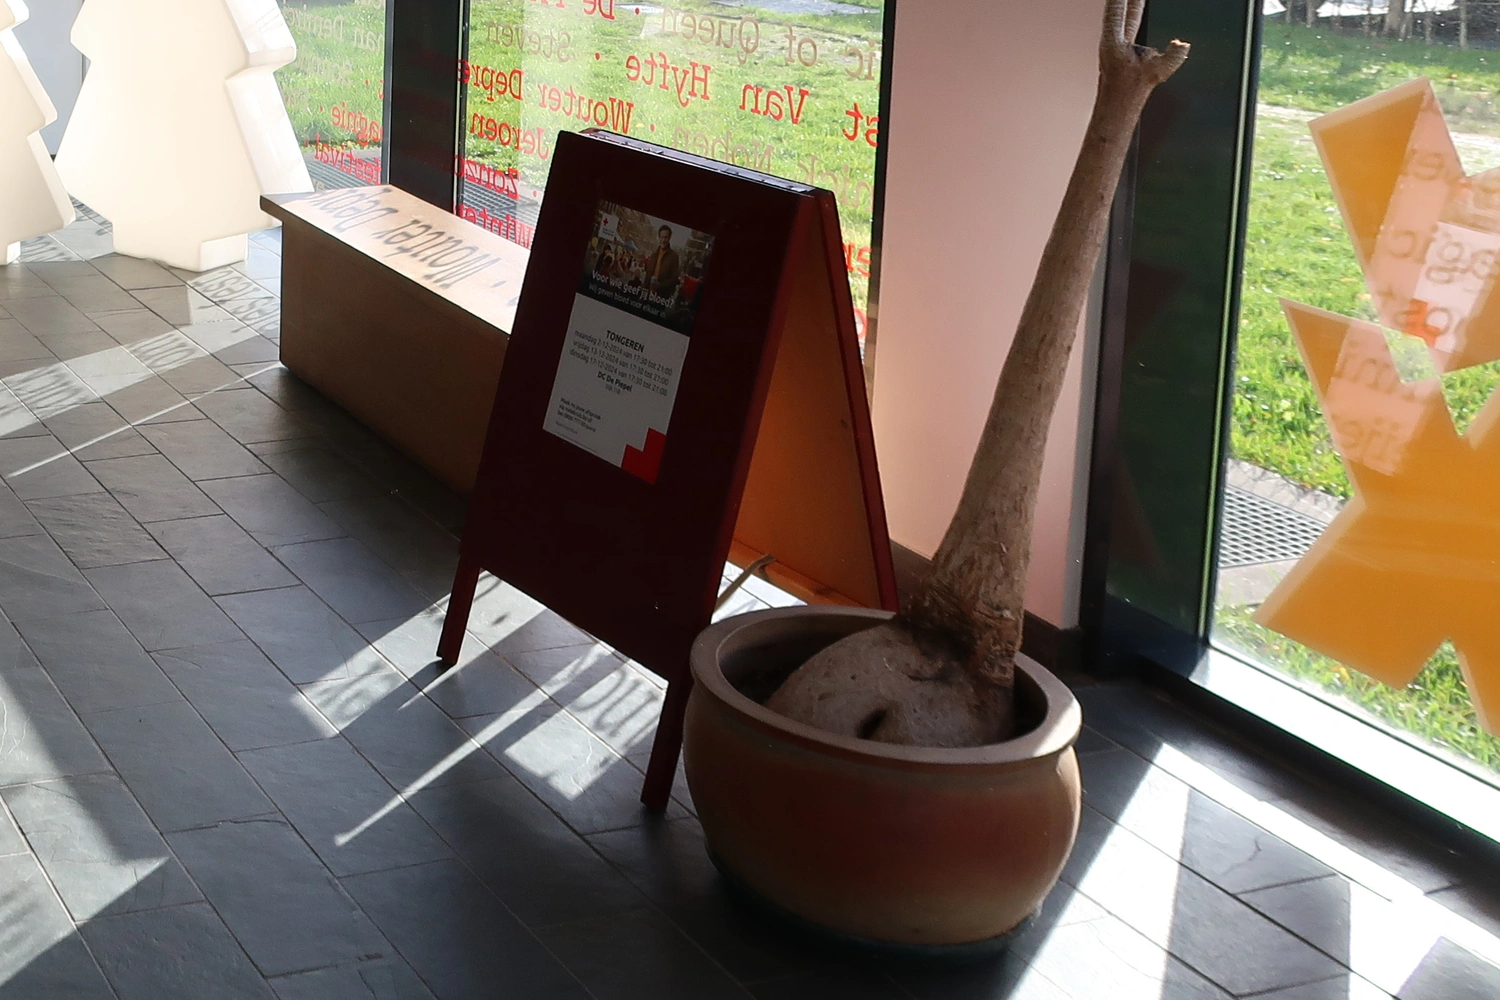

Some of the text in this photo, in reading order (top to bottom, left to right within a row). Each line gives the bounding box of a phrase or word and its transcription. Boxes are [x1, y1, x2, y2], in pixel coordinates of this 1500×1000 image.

[591, 270, 608, 284] Voor
[609, 278, 622, 290] wie
[623, 283, 640, 296] geef
[606, 330, 645, 353] TONGEREN
